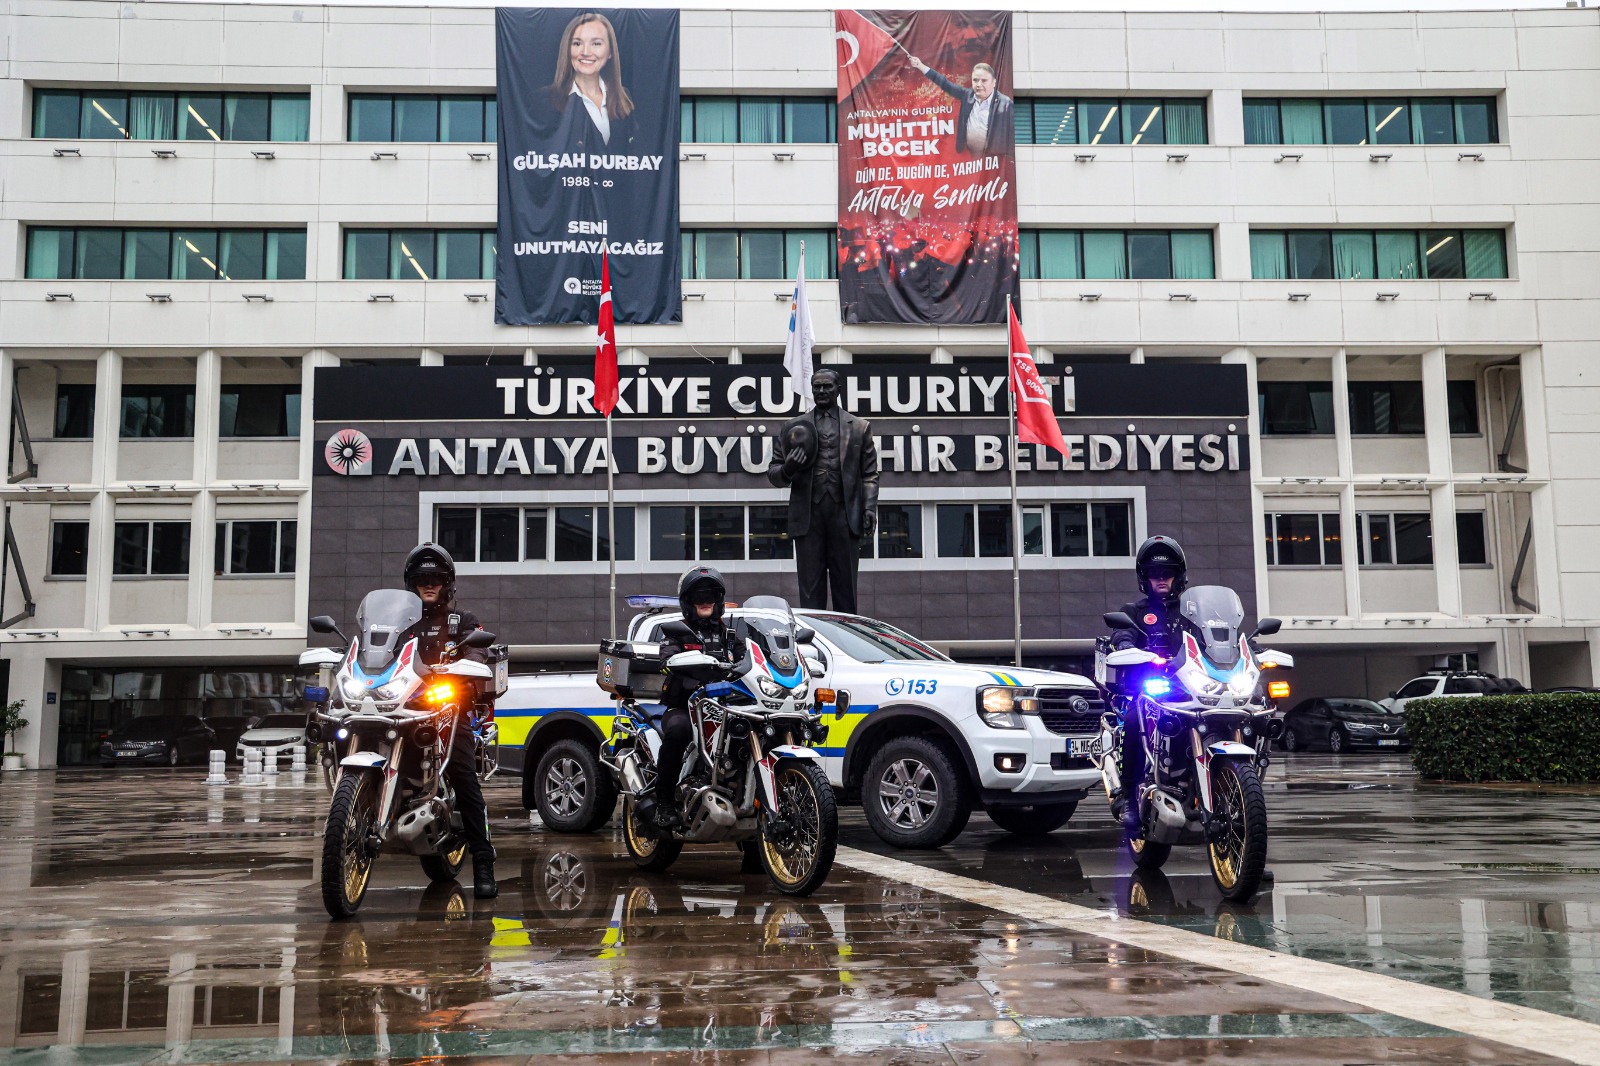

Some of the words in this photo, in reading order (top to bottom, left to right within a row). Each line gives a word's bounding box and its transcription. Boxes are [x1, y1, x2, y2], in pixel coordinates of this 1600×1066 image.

[847, 109, 908, 120] ANTALYA'NIN
[912, 105, 953, 116] GURURU
[848, 117, 954, 141] MUHİTTİN
[863, 137, 940, 158] BÖCEK
[513, 151, 586, 171] GÜLŞAH
[590, 155, 663, 171] DURBAY
[856, 168, 875, 184] DÜN
[878, 167, 894, 182] DE,
[897, 164, 932, 180] BUGÜN
[934, 164, 950, 179] DE,
[953, 158, 982, 176] YARIN
[986, 156, 999, 170] DA
[562, 176, 590, 187] 1988
[848, 184, 924, 216] Antalya
[933, 175, 1009, 210] Seninle
[568, 220, 608, 235] SENİ
[513, 239, 664, 256] UNUTMAYACAĞIZ
[1016, 359, 1032, 373] TSE
[1025, 379, 1044, 395] 9000
[388, 437, 620, 475] ANTALYA
[638, 424, 957, 474] BÜYÜHİR
[974, 423, 1240, 472] BELEDİYESİ
[907, 679, 938, 695] 153
[1071, 741, 1079, 753] 34
